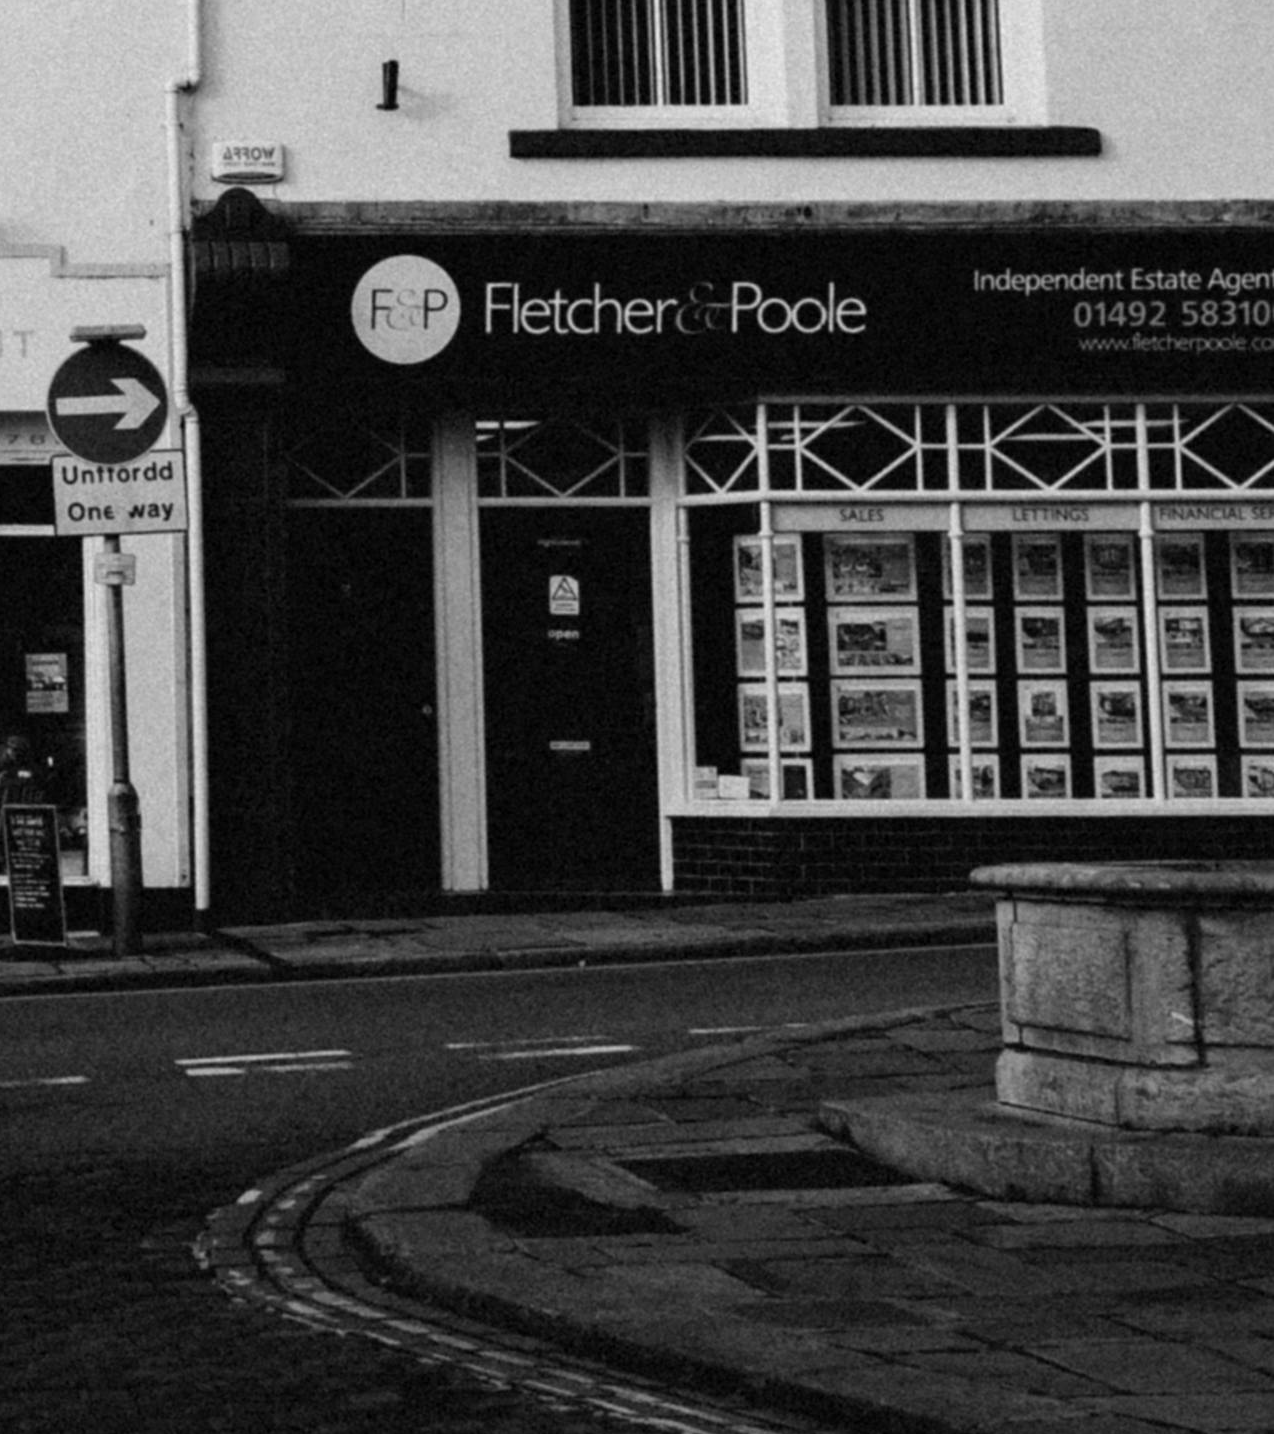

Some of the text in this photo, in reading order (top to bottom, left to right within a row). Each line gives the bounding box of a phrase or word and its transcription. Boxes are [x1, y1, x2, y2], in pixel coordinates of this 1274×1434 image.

[973, 267, 1125, 296] Independent
[1131, 267, 1203, 291] Estate
[369, 287, 451, 331] F&P
[1073, 300, 1274, 327] 01492 58310
[68, 502, 174, 522] One way
[839, 507, 884, 522] SALES
[1011, 506, 1090, 522] LETTINGS
[1159, 505, 1245, 521] FINANCIAL
[547, 629, 580, 641] open
